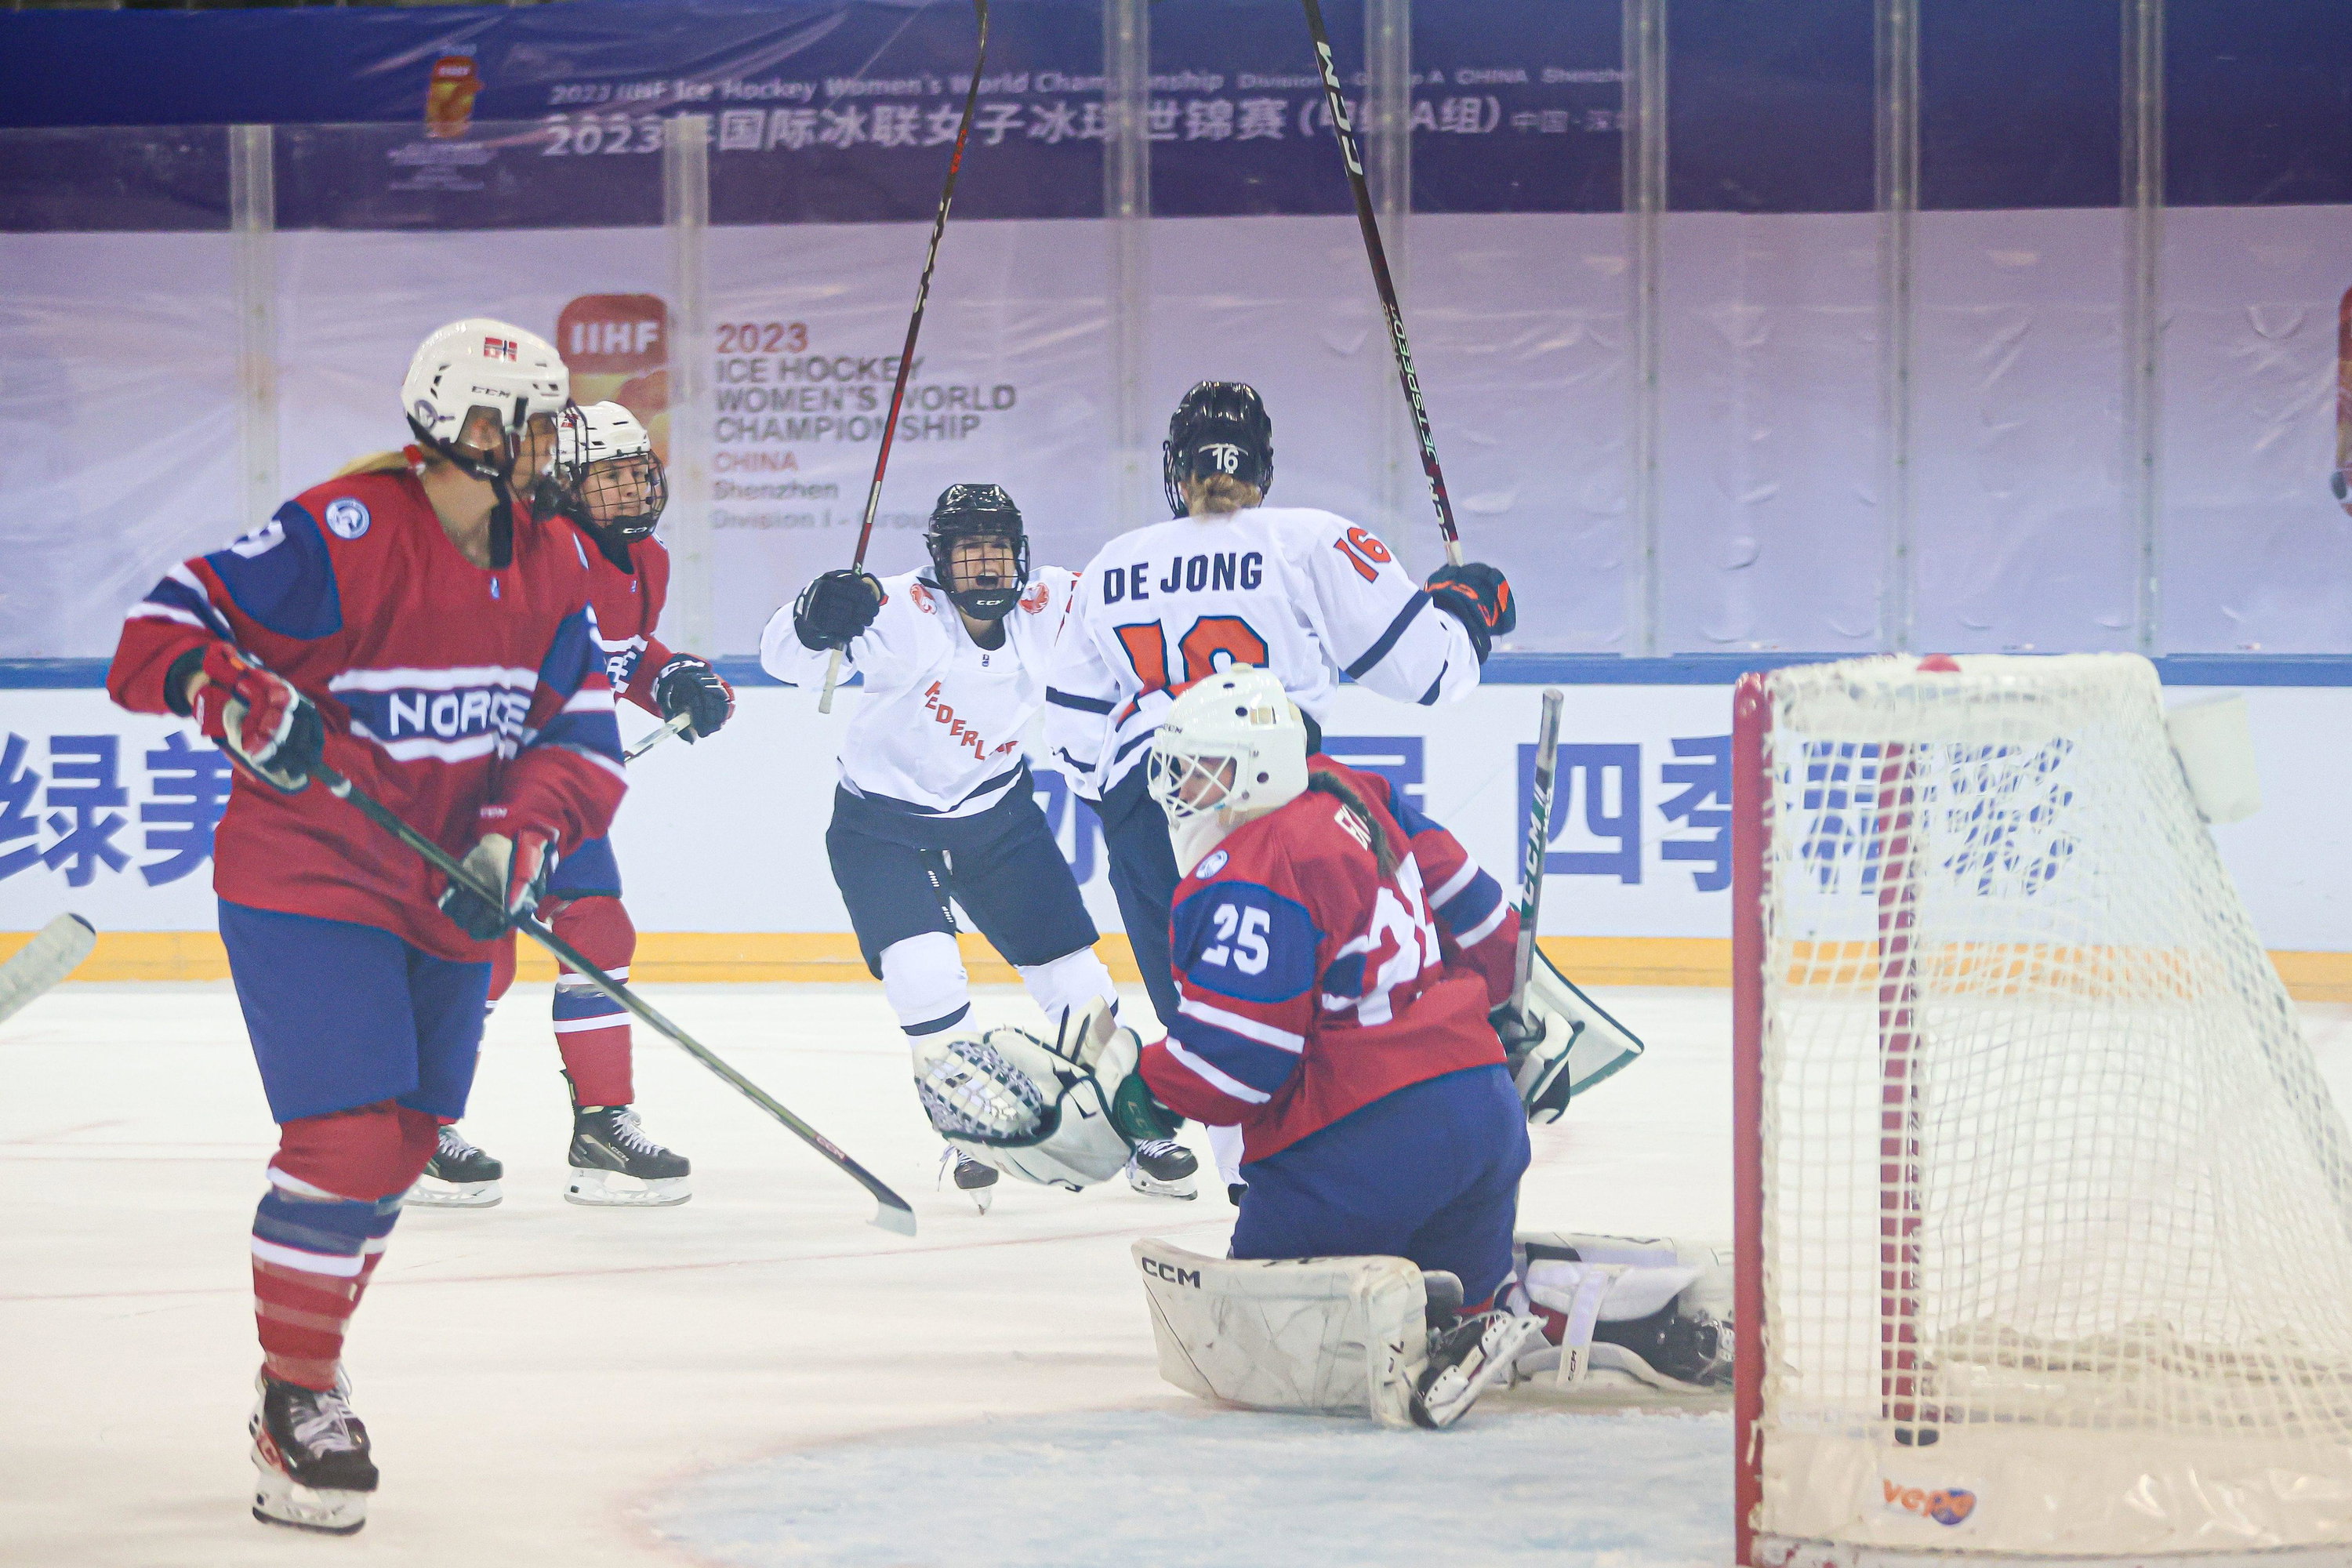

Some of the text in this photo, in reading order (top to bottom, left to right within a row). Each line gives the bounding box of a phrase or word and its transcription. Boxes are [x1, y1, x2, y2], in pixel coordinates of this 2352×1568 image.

[721, 79, 817, 103] Hockey
[826, 73, 942, 96] Women's
[1317, 42, 1363, 175] CCM
[571, 321, 658, 354] IIHF
[716, 322, 808, 354] 2023
[716, 355, 925, 383] ICE HOCKEY
[715, 386, 878, 413] WOMEN'S
[1394, 319, 1439, 466] JETSPEED
[714, 451, 799, 473] CHINA
[1212, 445, 1240, 472] 16
[711, 479, 839, 501] Shenzhen
[710, 509, 814, 529] Division
[1334, 526, 1392, 583] 16
[1103, 551, 1264, 605] DE JONG
[1201, 903, 1270, 977] 25
[1142, 1256, 1202, 1289] CCM
